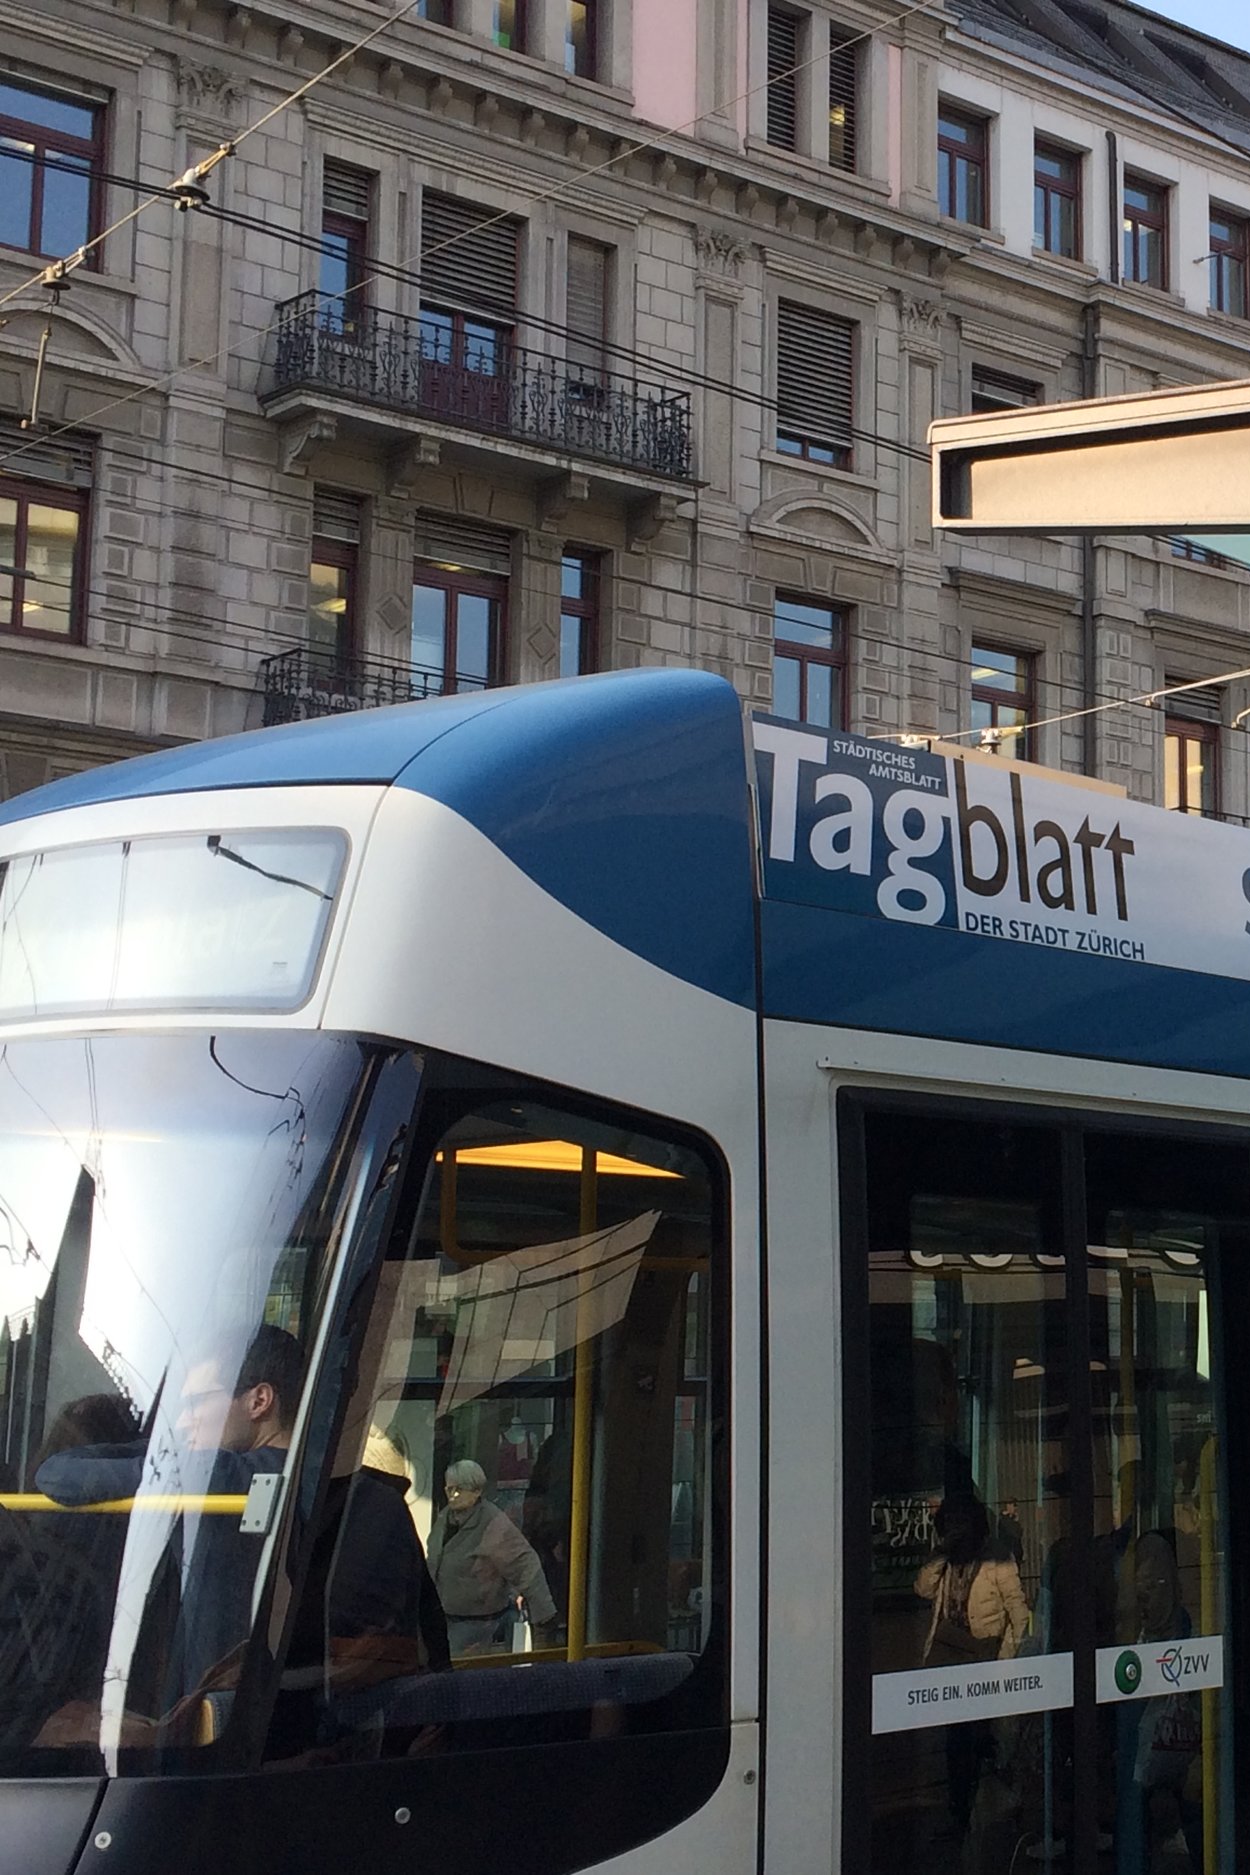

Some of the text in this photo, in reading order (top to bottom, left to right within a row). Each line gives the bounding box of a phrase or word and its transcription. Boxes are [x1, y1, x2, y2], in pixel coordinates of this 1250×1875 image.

[832, 739, 916, 770] STÄDTISCHES
[868, 764, 942, 791] AMTSBLATT
[752, 722, 1135, 927] Tagblatt
[964, 911, 1146, 961] DER STADT ZÜRICH
[1183, 1653, 1210, 1676] ZVV
[907, 1675, 1044, 1706] STEIG EIN. KOMM WEITER.
